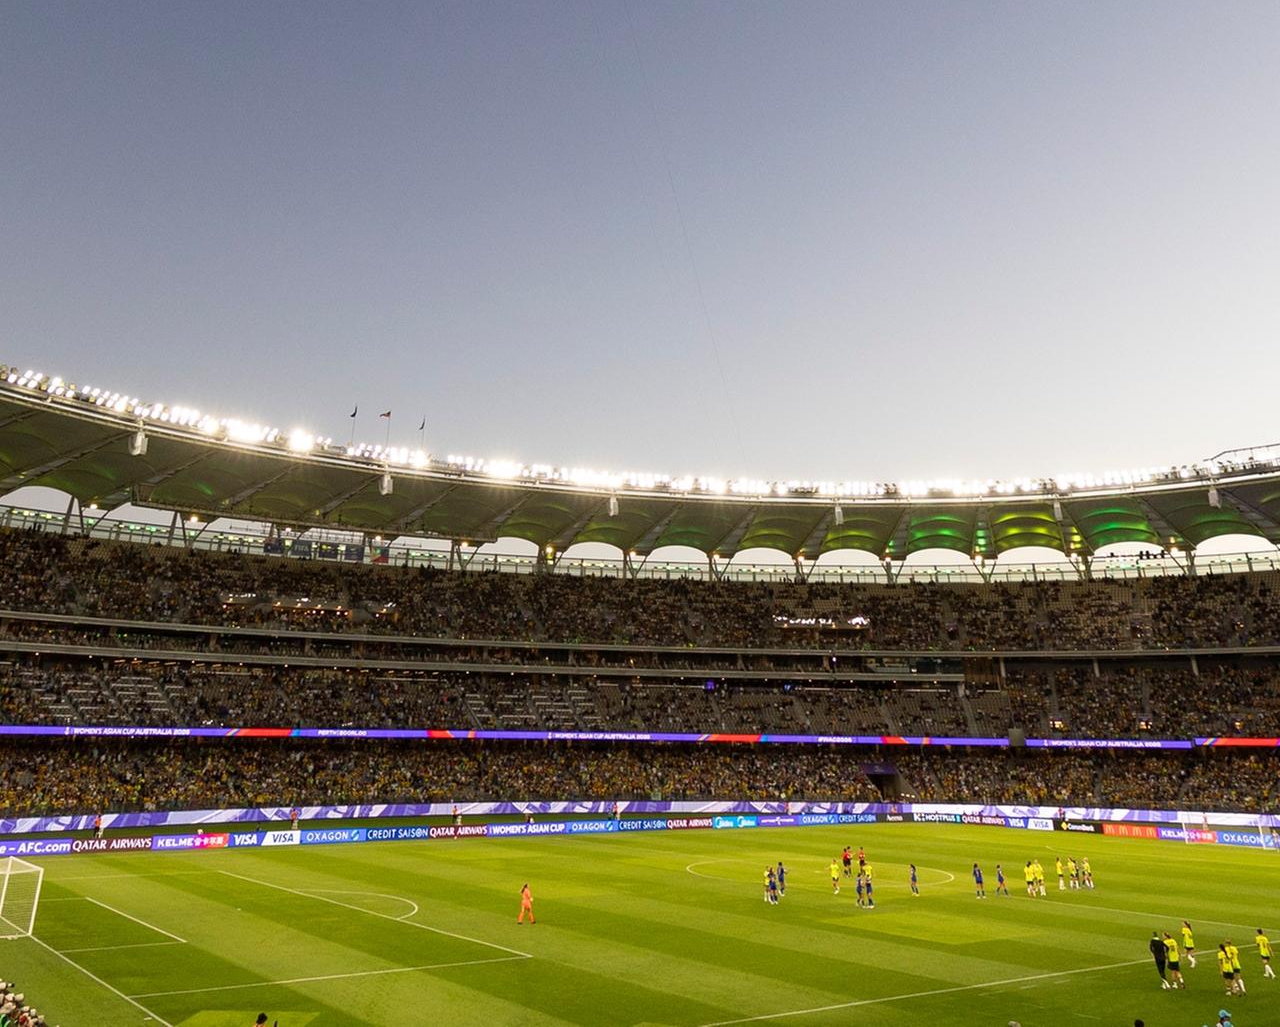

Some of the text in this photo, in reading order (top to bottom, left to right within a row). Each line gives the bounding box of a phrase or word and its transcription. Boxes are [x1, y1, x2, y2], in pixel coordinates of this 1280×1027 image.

[802, 815, 828, 823] OXAGON
[839, 814, 876, 823] CREDIT SAISON
[961, 815, 981, 824] QATAR
[1008, 817, 1025, 827] VISA
[492, 824, 565, 834] WOMEN'S ASIAN CUP
[572, 823, 604, 831] OXAGON
[619, 820, 666, 830] CREDIT SAISON
[667, 819, 713, 829] QATAR AIRWAYS
[1033, 820, 1049, 828] VISA
[307, 831, 348, 841] OXAGON
[367, 828, 428, 839] CREDIT SAISON
[429, 826, 487, 838] QATAR AIRWAYS
[157, 837, 194, 847] KELME
[233, 834, 257, 845] VISA
[272, 833, 294, 843] VISA
[1223, 833, 1263, 844] OXAGON
[17, 841, 71, 854] AFC.com
[72, 838, 152, 852] QATAR AIRWAYS
